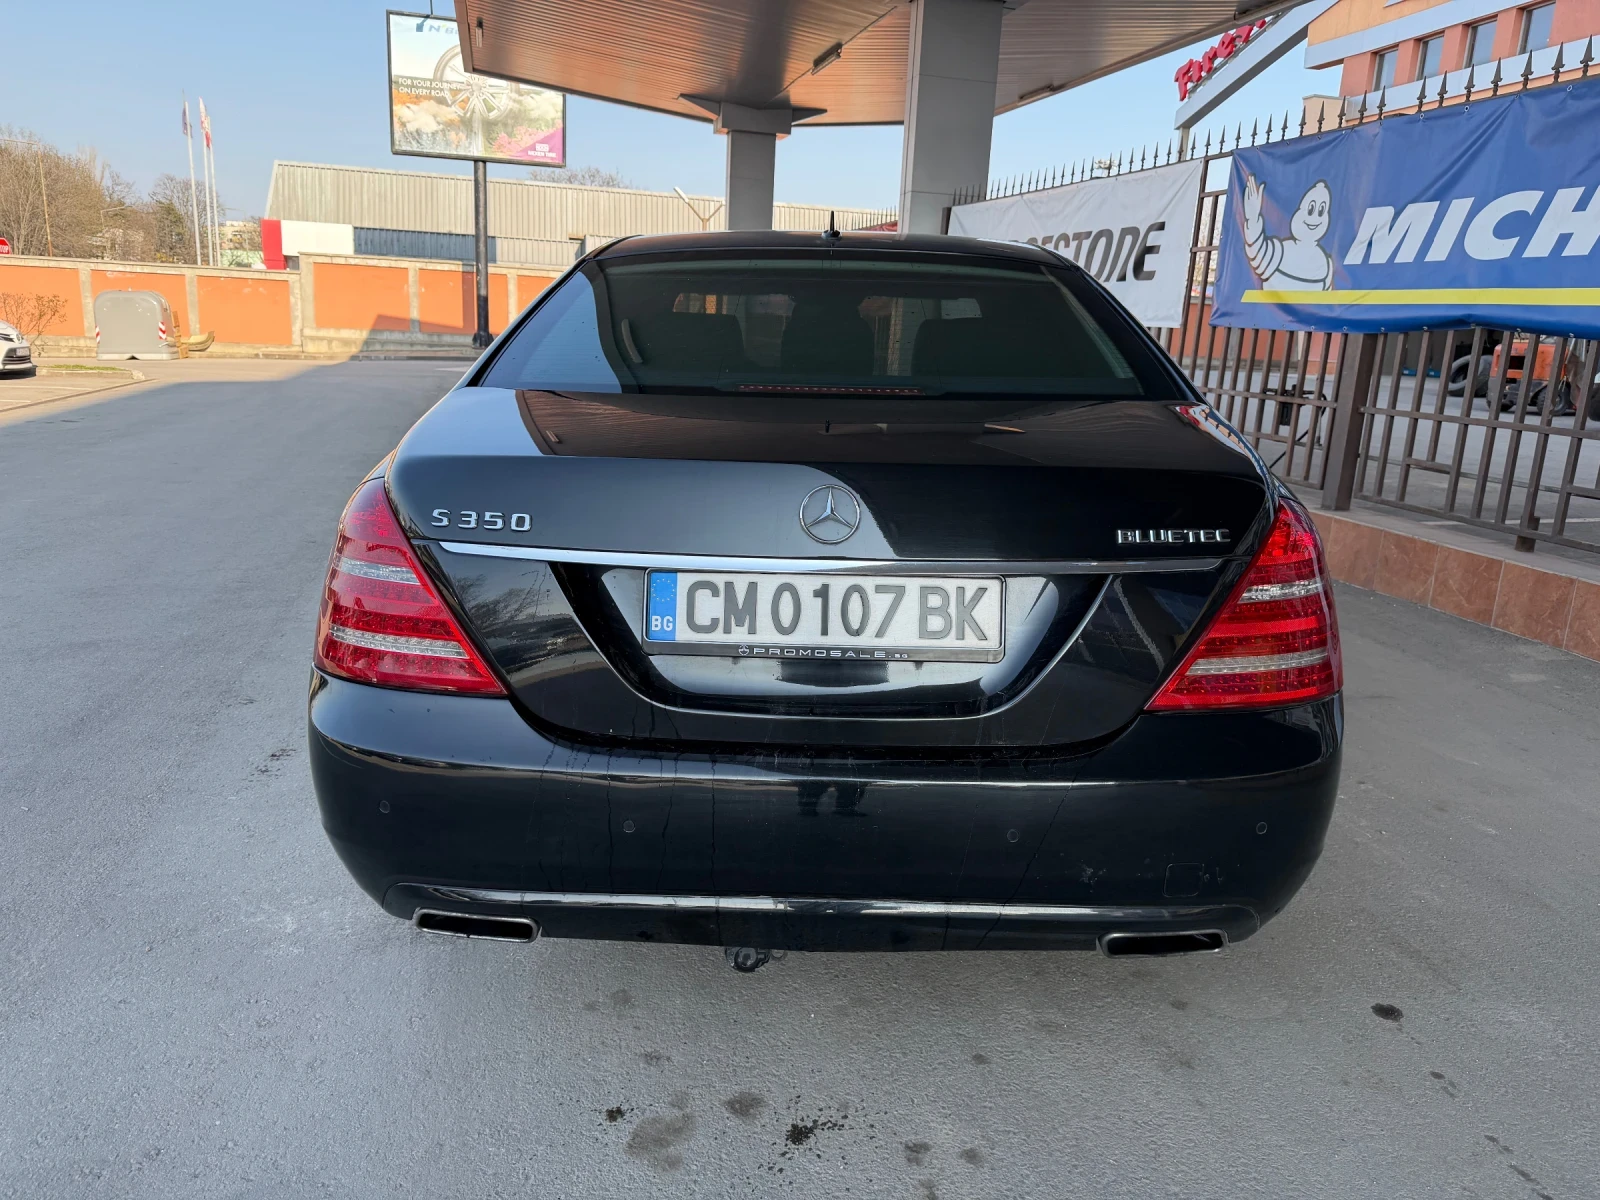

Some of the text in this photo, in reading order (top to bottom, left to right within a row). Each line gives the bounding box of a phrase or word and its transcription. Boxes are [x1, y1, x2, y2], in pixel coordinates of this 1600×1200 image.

[398, 77, 460, 91] FOR YOUR JOURNEY
[398, 86, 450, 98] ON EVERY ROAD
[1342, 183, 1600, 265] MICH
[430, 508, 533, 532] S 350
[1117, 528, 1231, 544] BLUETEC
[686, 580, 988, 641] CM 0107 BK
[651, 615, 673, 632] BG
